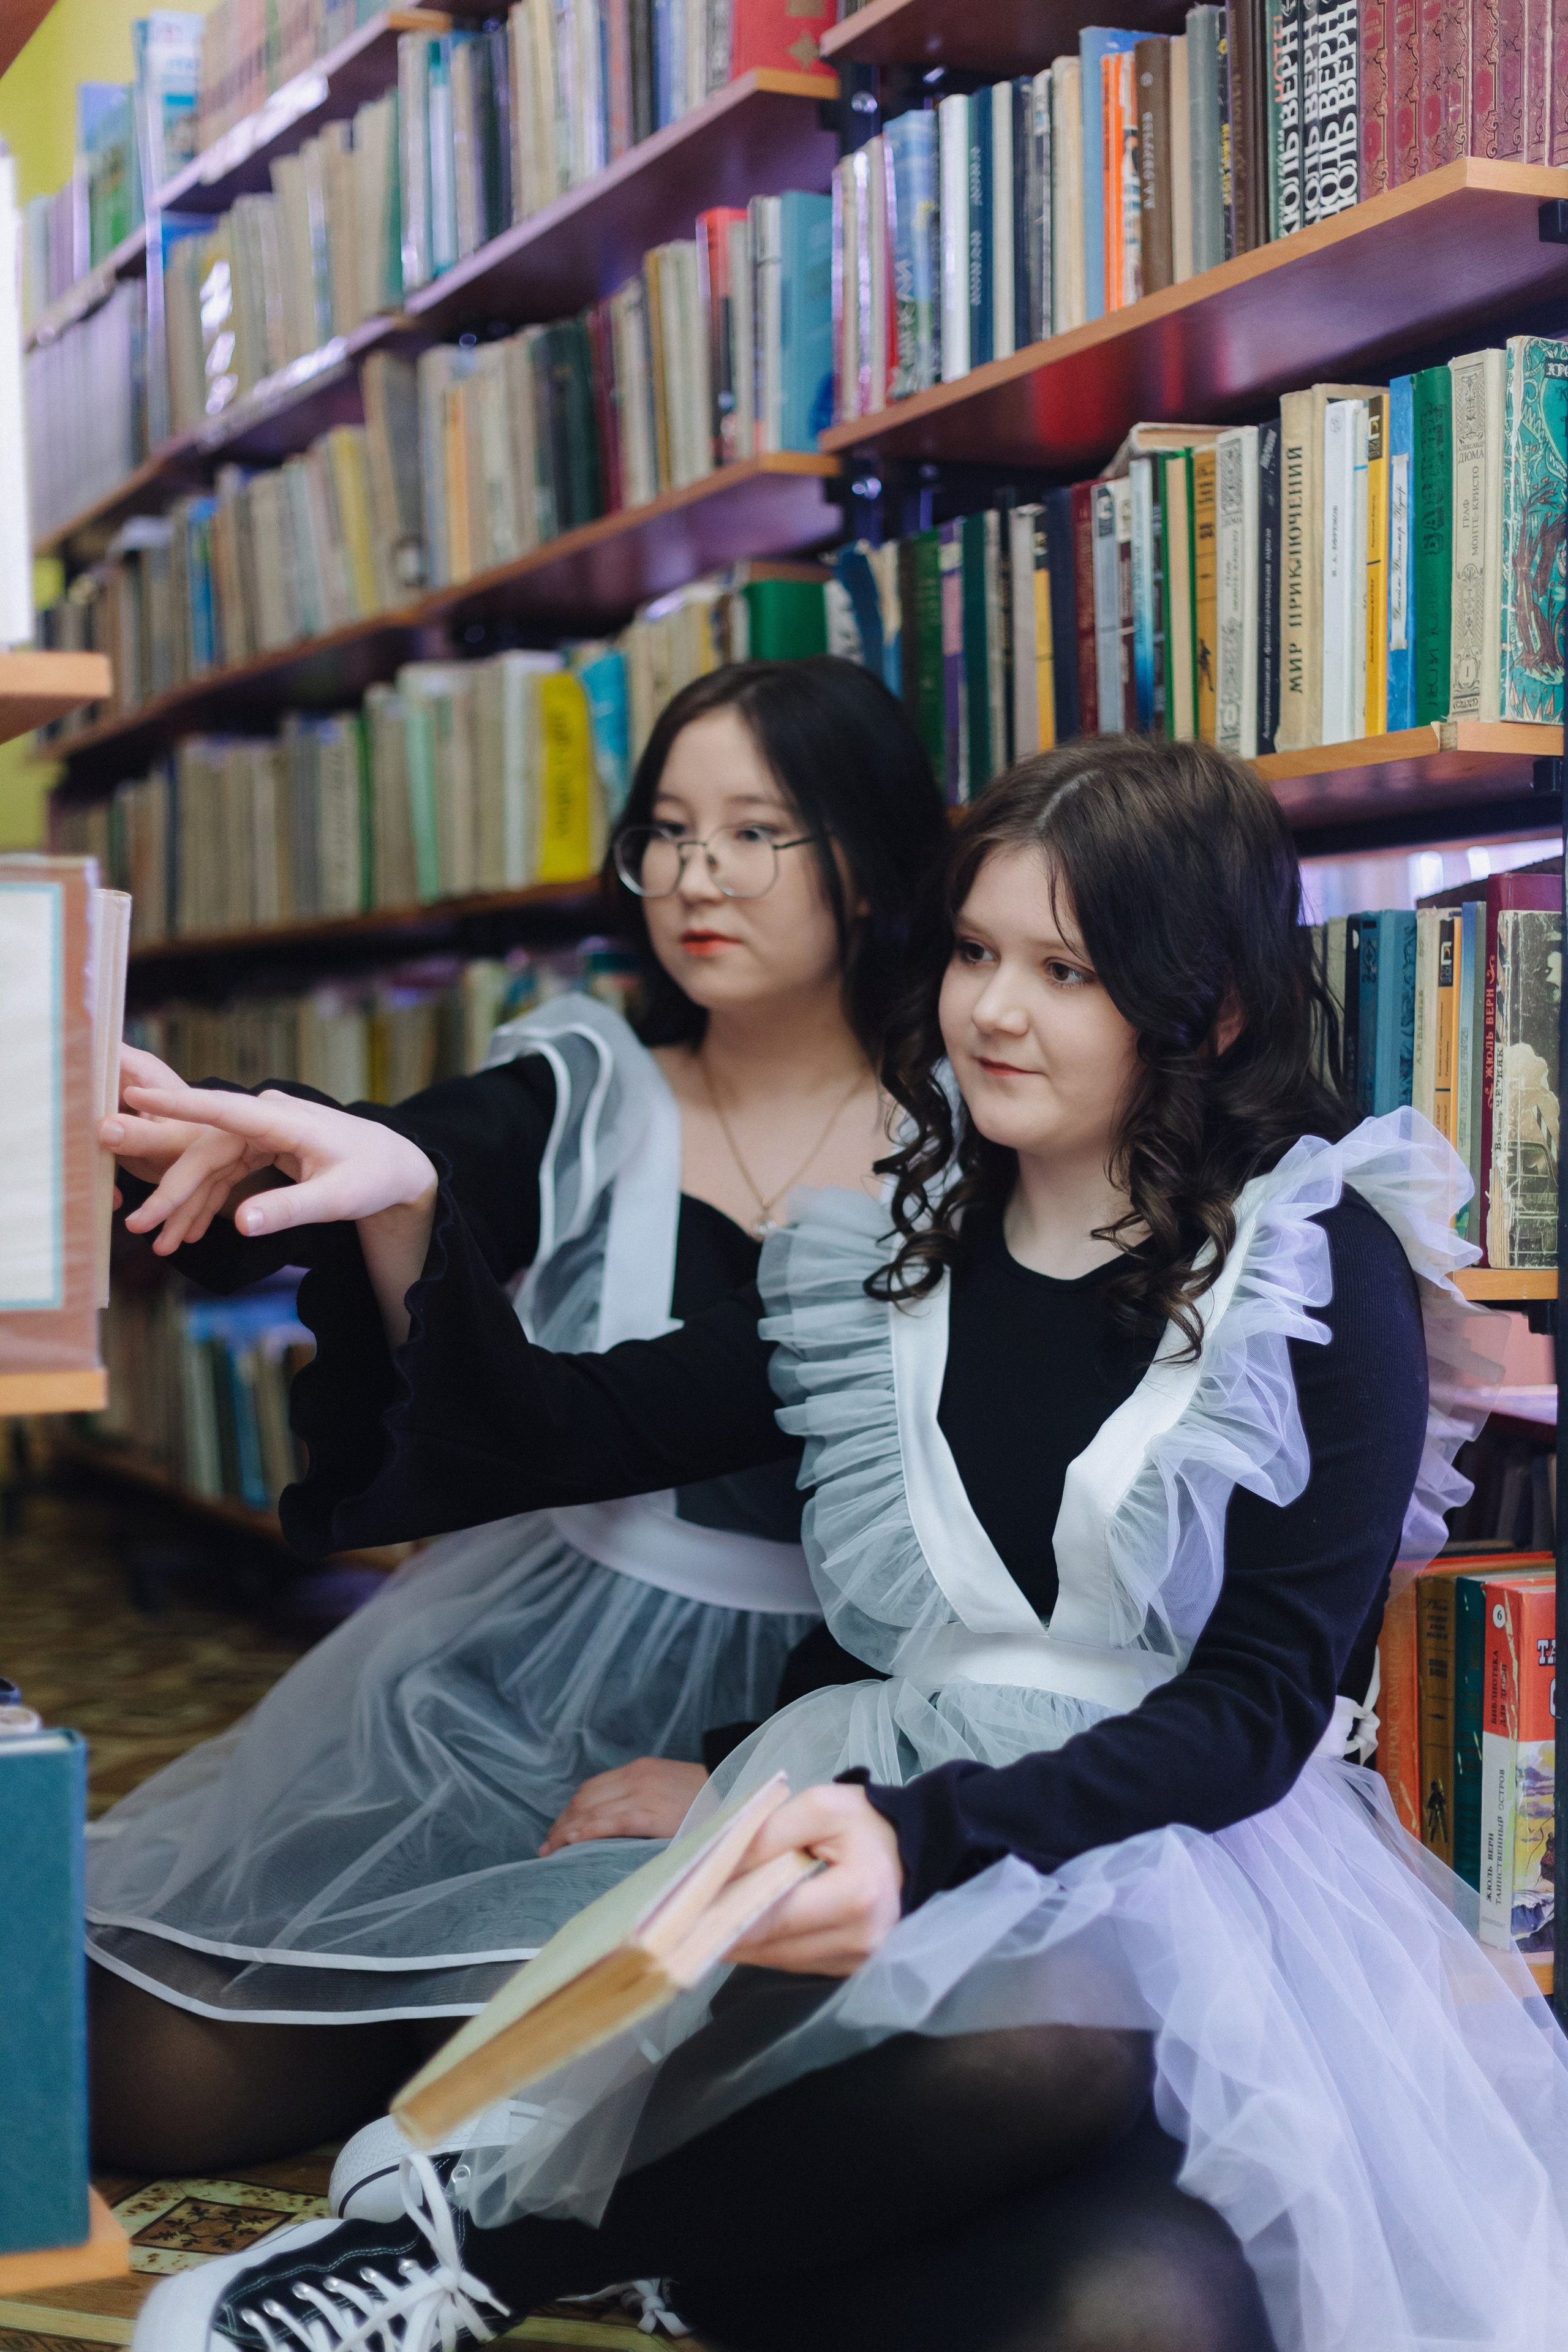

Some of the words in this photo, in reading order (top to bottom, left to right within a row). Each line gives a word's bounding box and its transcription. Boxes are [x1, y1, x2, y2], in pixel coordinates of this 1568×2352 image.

[1282, 20, 1298, 129] ВЕРН
[1304, 13, 1319, 124] ВЕРН
[1318, 4, 1341, 120] ВЕРН
[1337, 0, 1358, 109] ВЕРН
[1304, 126, 1320, 224] ЮЛЬ
[1319, 121, 1341, 216] ЮЛЬ
[1338, 112, 1358, 210] ЮЛЬ
[1458, 448, 1485, 464] ДЮМА
[1287, 447, 1303, 627] ПРИКЛЮЧЕНИЙ
[1289, 643, 1303, 694] МИР
[1486, 988, 1494, 1025] ВЕРН
[1485, 1031, 1494, 1079] ЖЮЛЬ
[1494, 1111, 1502, 1152] Виктор
[1496, 1610, 1502, 1621] 6
[1495, 1815, 1504, 1905] ТАИНСТВЕННЫЙ
